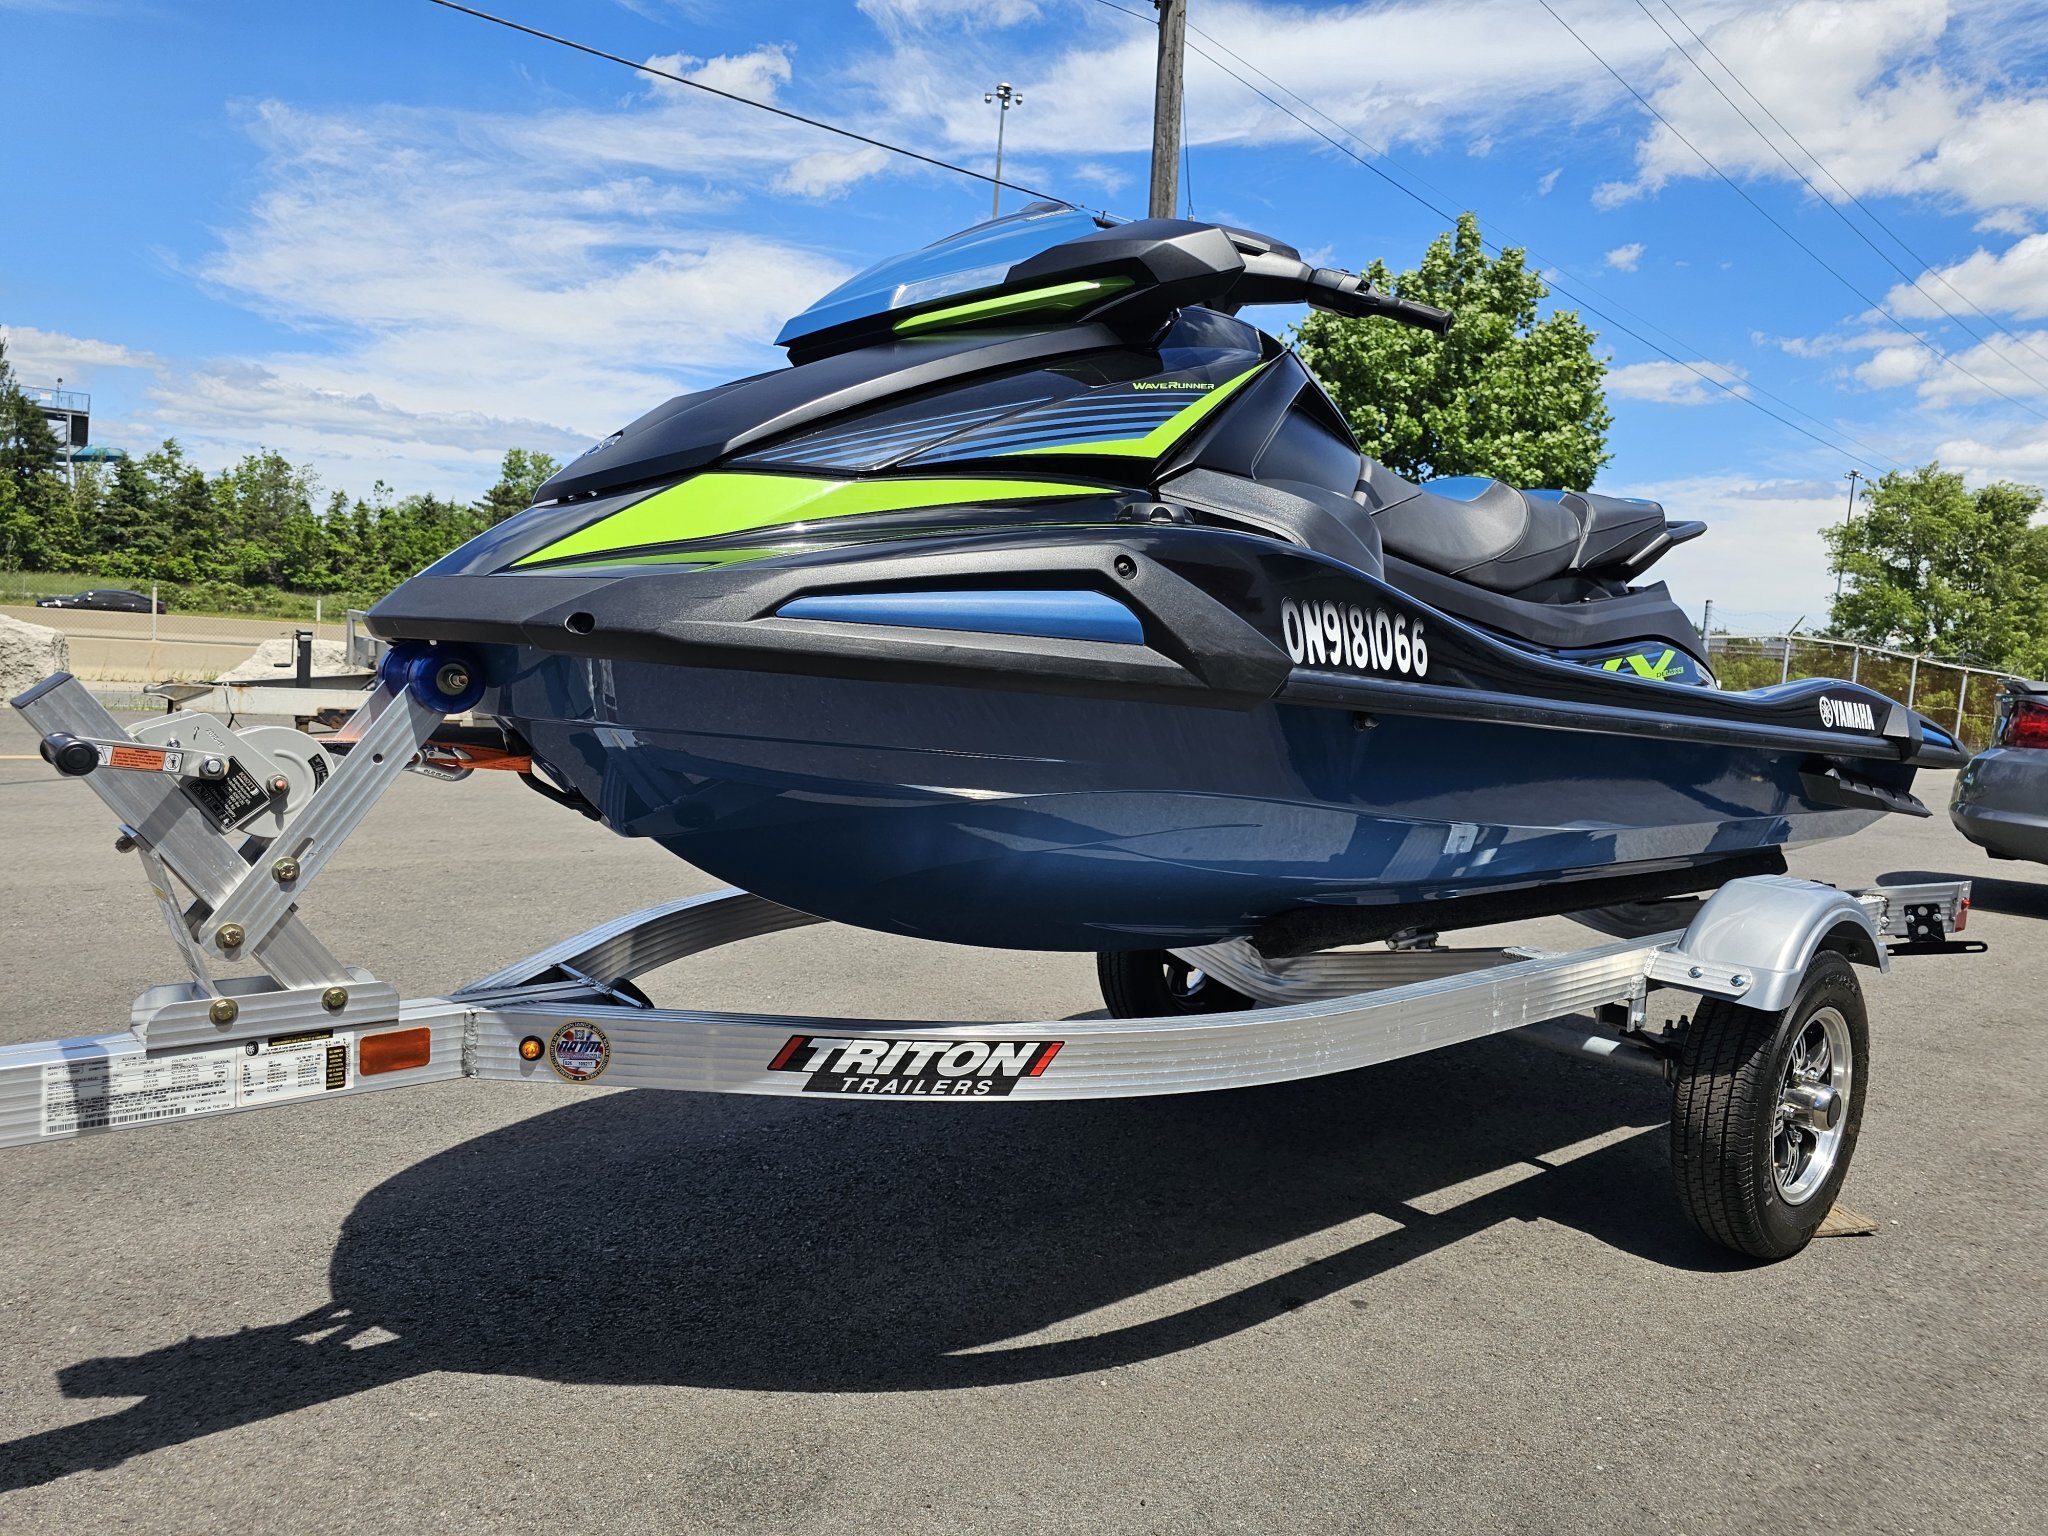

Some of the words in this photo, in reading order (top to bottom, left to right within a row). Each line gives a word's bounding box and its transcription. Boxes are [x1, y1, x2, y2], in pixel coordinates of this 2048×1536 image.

[1281, 596, 1429, 677] ON9181066
[1830, 699, 1876, 731] YAMAHA
[239, 771, 256, 790] KNOTT
[801, 1037, 1041, 1077] TRITON
[840, 1077, 993, 1096] TRAILERS
